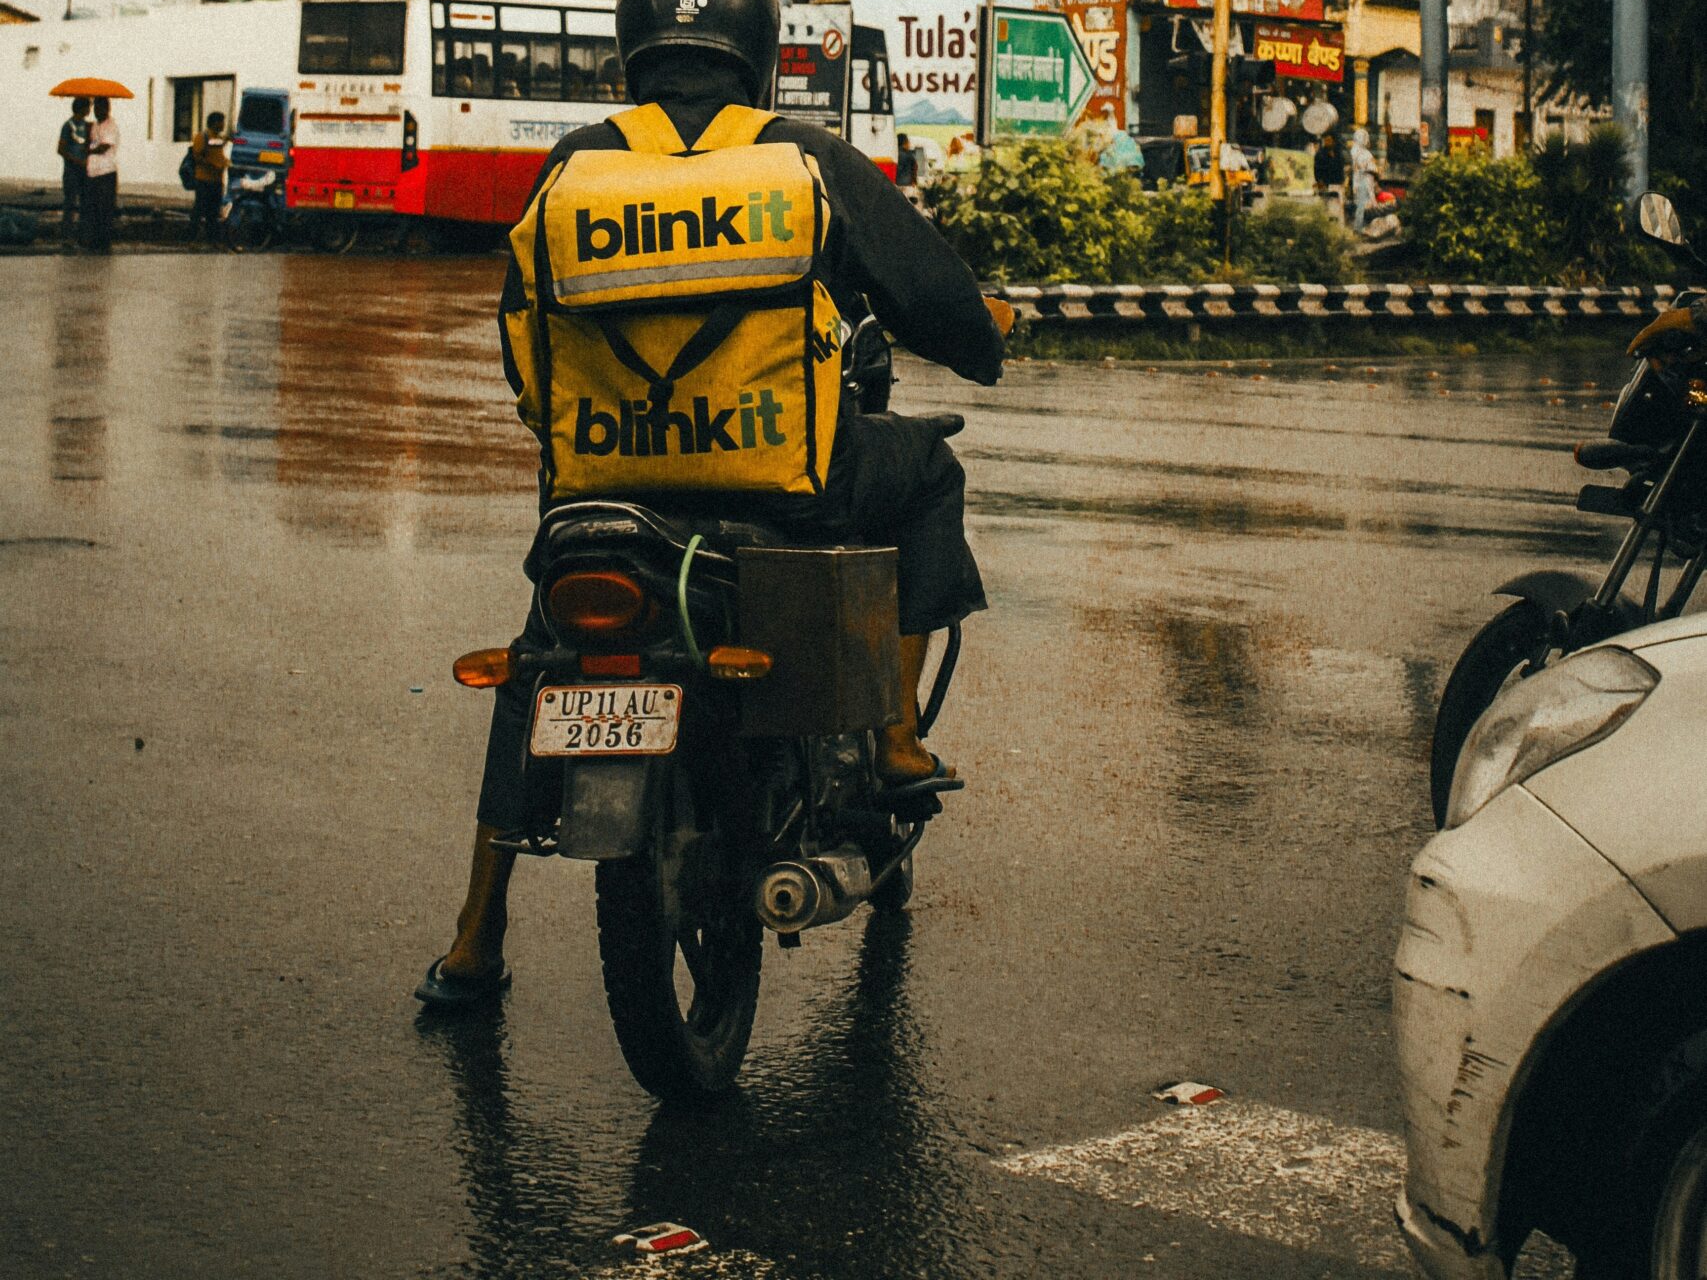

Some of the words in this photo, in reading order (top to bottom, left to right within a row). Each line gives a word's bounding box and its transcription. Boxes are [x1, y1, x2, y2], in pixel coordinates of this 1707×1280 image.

[576, 189, 794, 262] blinkit
[574, 388, 787, 457] blinkit
[624, 690, 658, 715] AU
[565, 722, 643, 748] 2056
